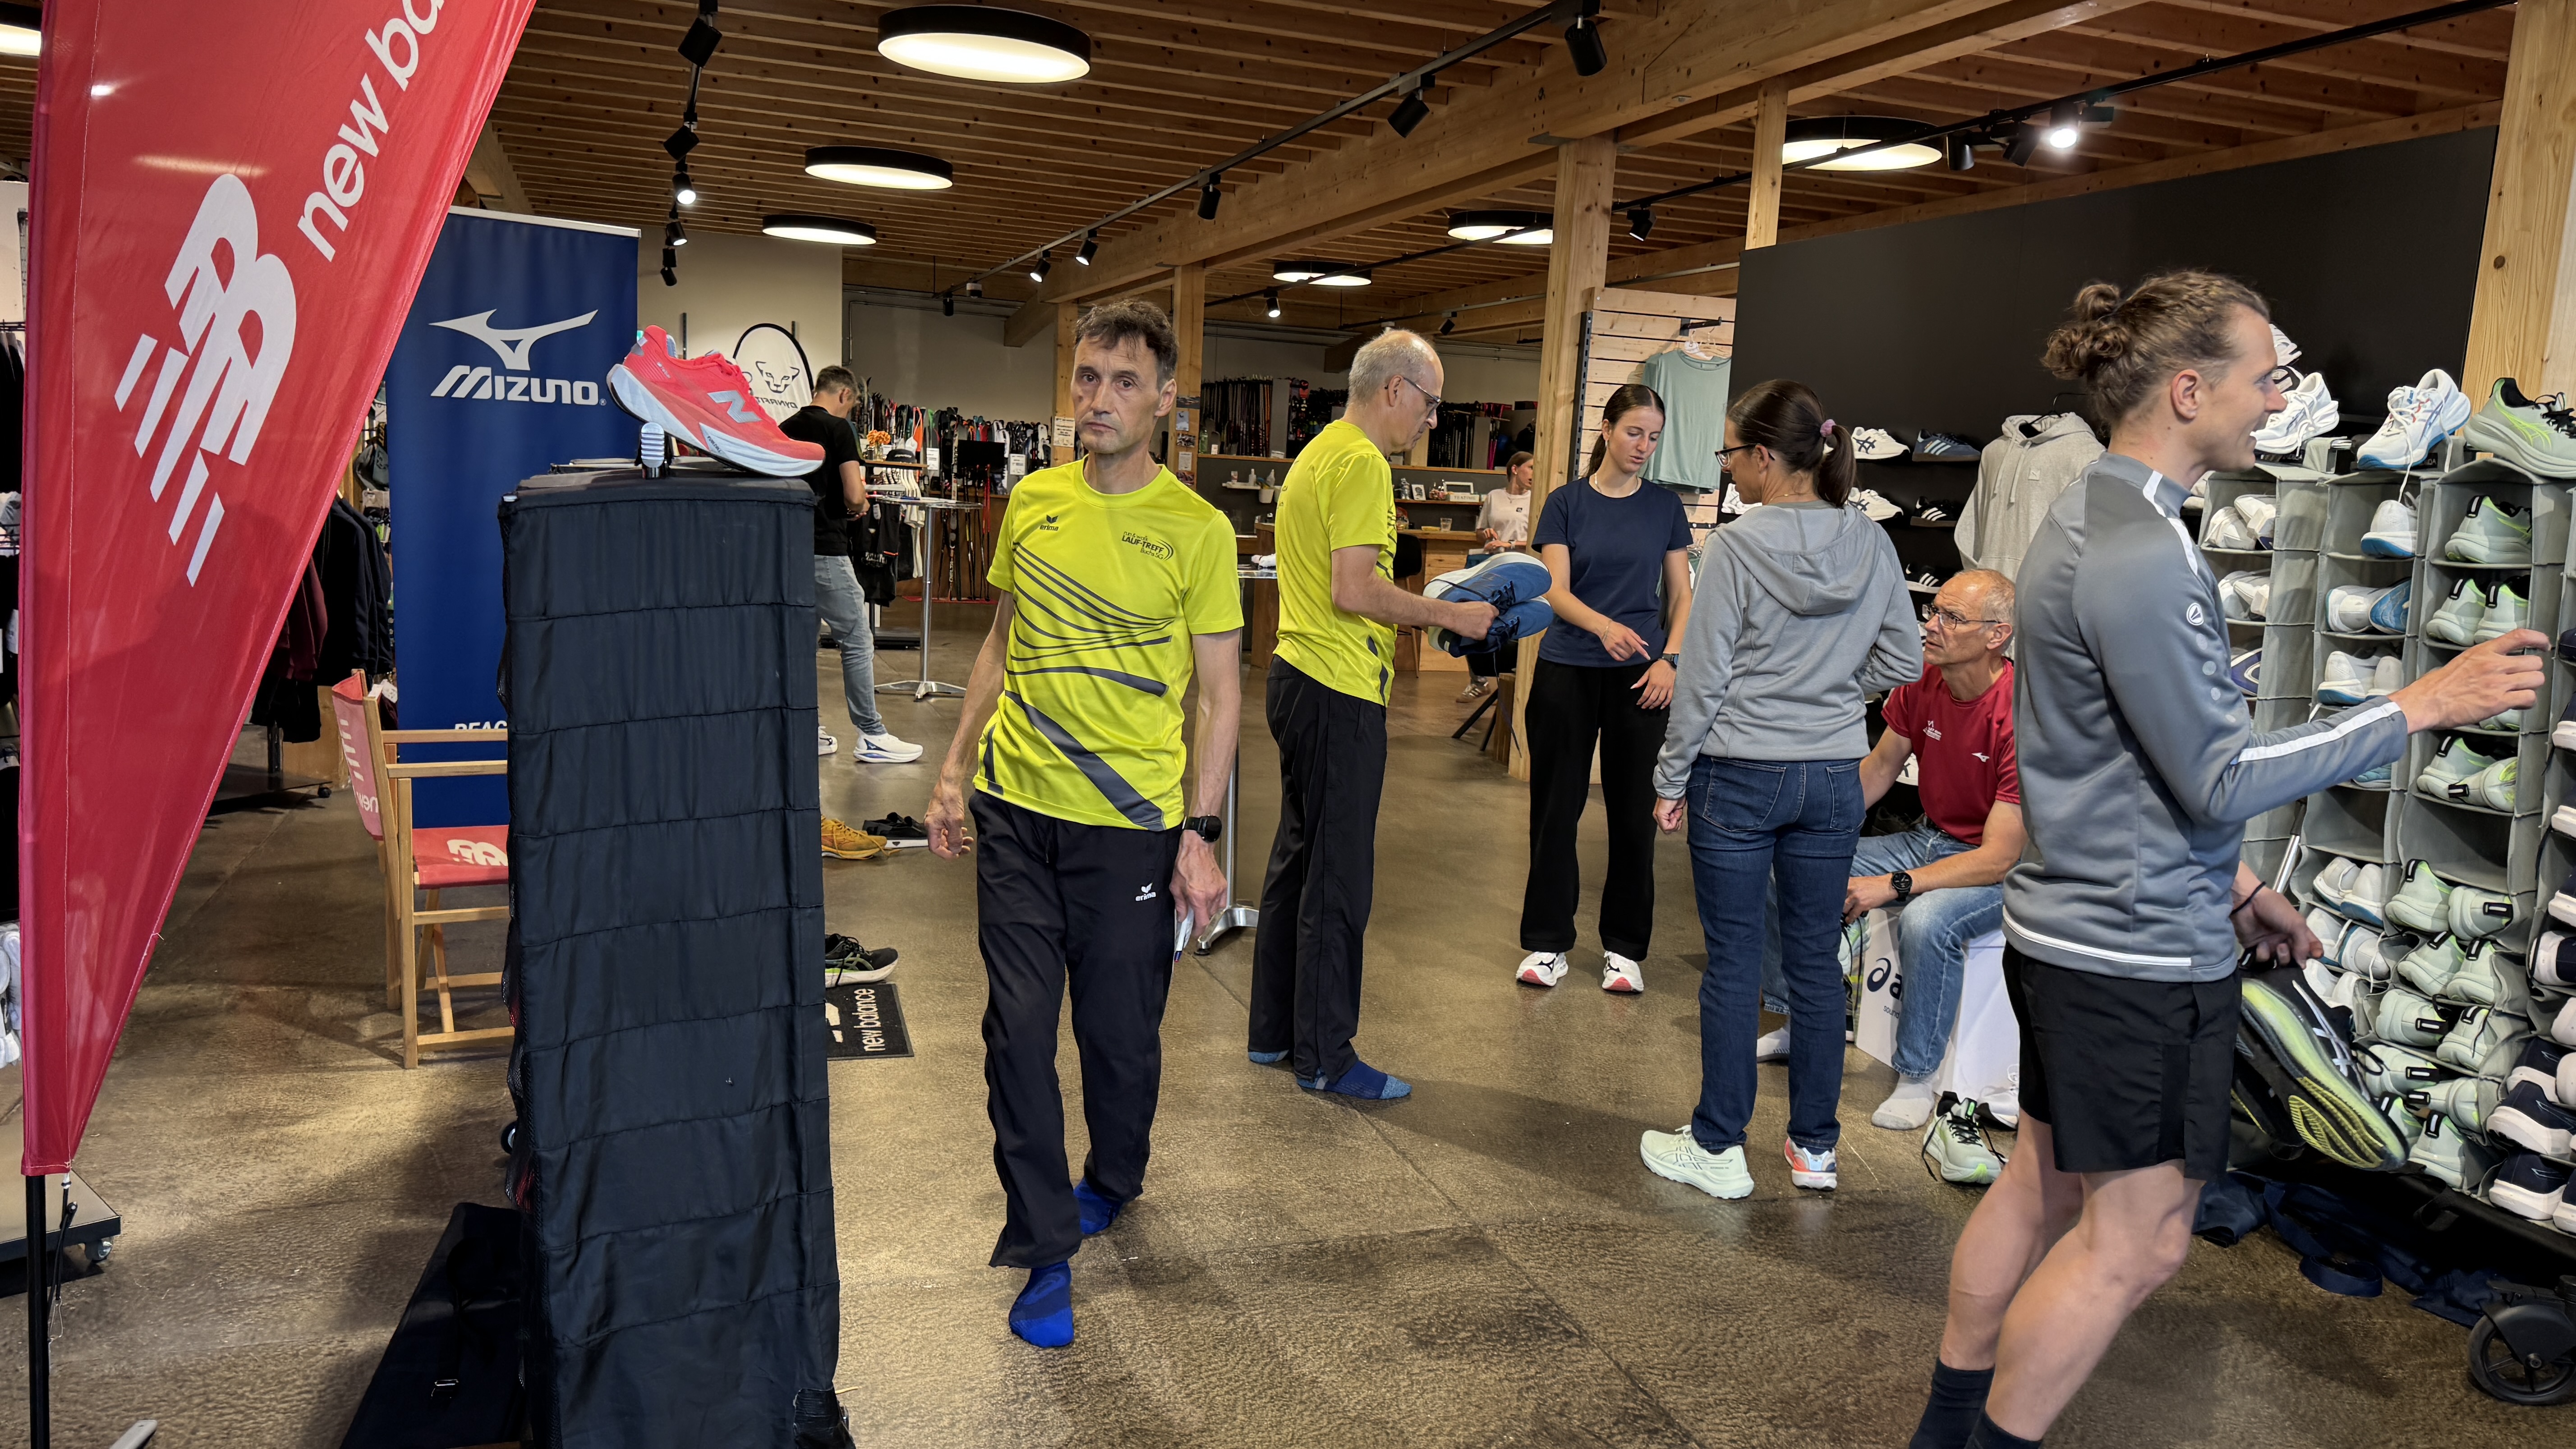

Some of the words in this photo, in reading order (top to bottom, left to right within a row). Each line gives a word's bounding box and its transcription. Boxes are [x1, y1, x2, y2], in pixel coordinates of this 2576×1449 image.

[297, 72, 390, 262] new
[1122, 535, 1164, 553] LAUF-TREFF
[852, 988, 882, 1029] balance
[861, 1029, 886, 1052] new
